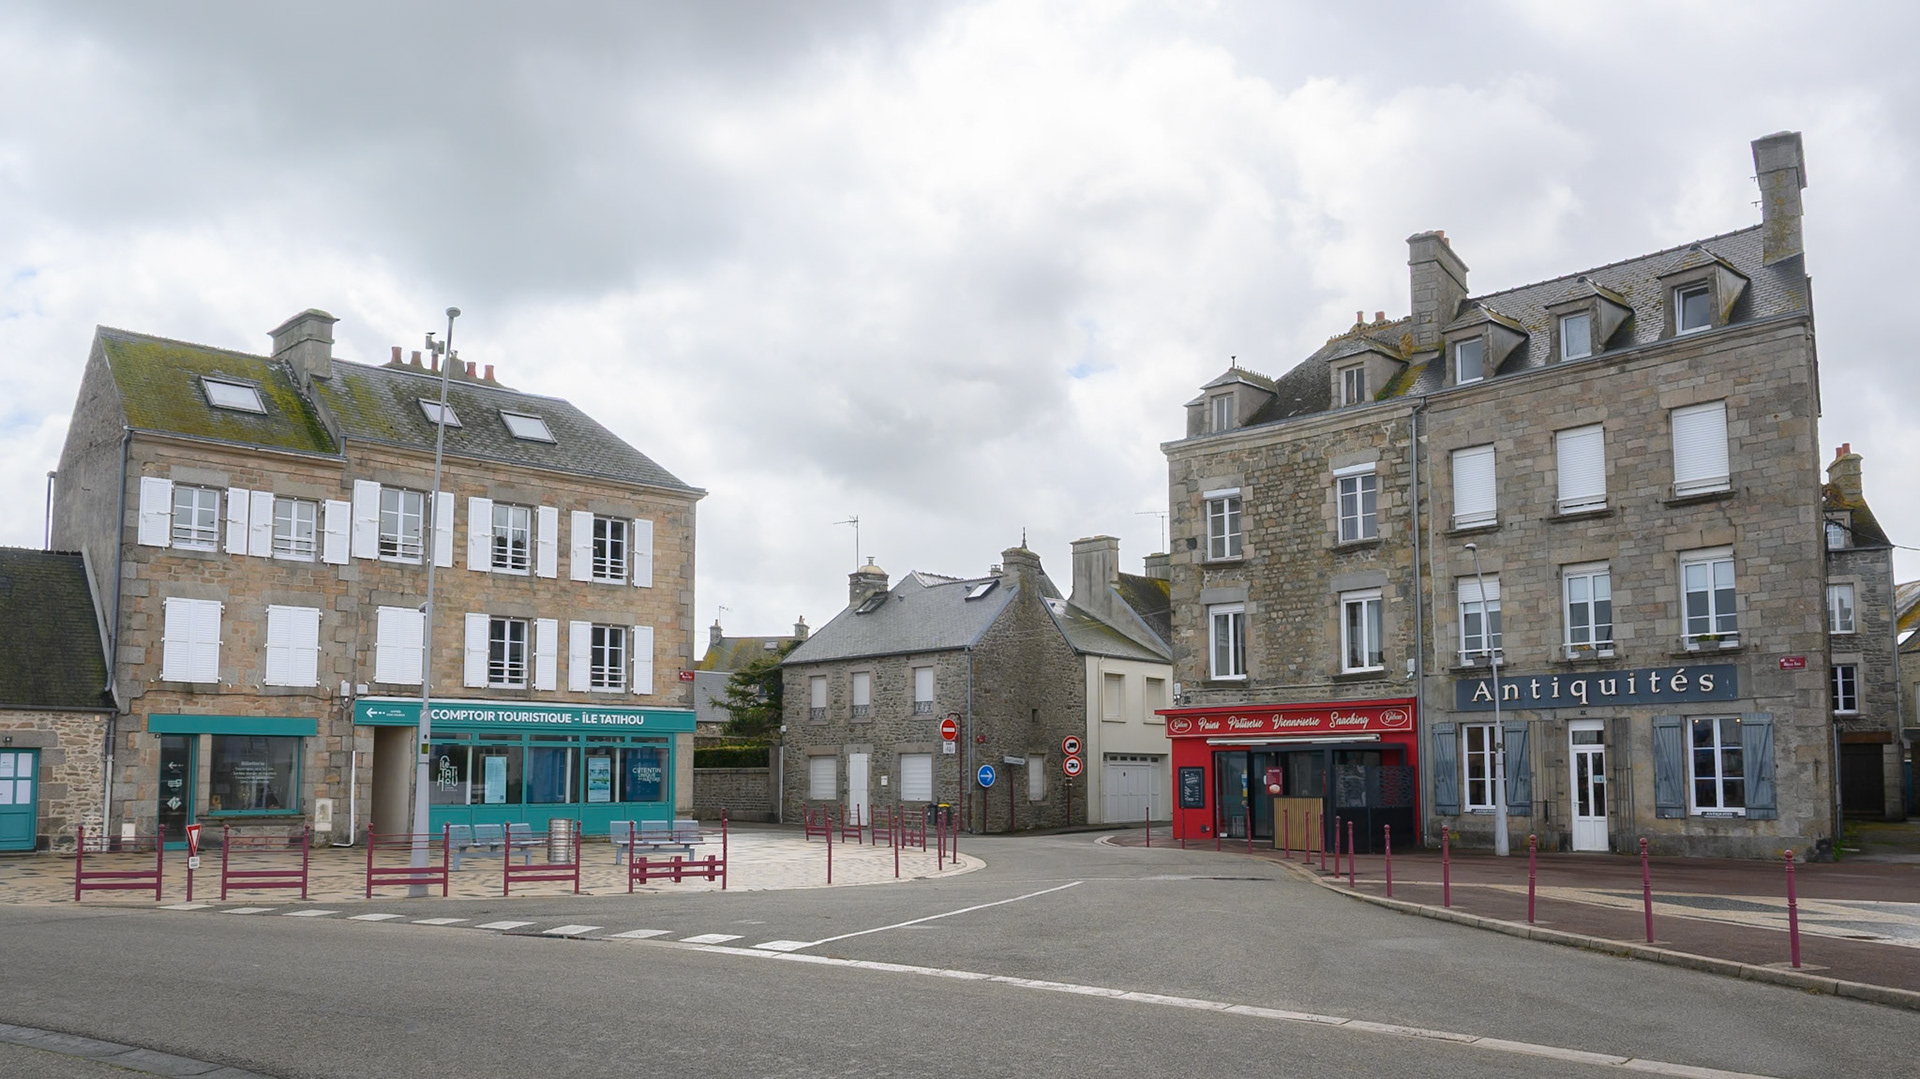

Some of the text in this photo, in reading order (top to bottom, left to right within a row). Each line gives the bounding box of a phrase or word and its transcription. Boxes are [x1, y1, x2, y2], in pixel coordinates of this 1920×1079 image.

[1471, 668, 1714, 704] Antiquités
[431, 709, 495, 722] COMPTOIR
[497, 711, 572, 723] TOURISTIQUE
[582, 711, 598, 724] ÎLE
[599, 714, 644, 725] TATIHOU
[1198, 717, 1220, 732] Pains
[1272, 714, 1321, 730] Viennoiserie
[1329, 711, 1369, 729] Snacking
